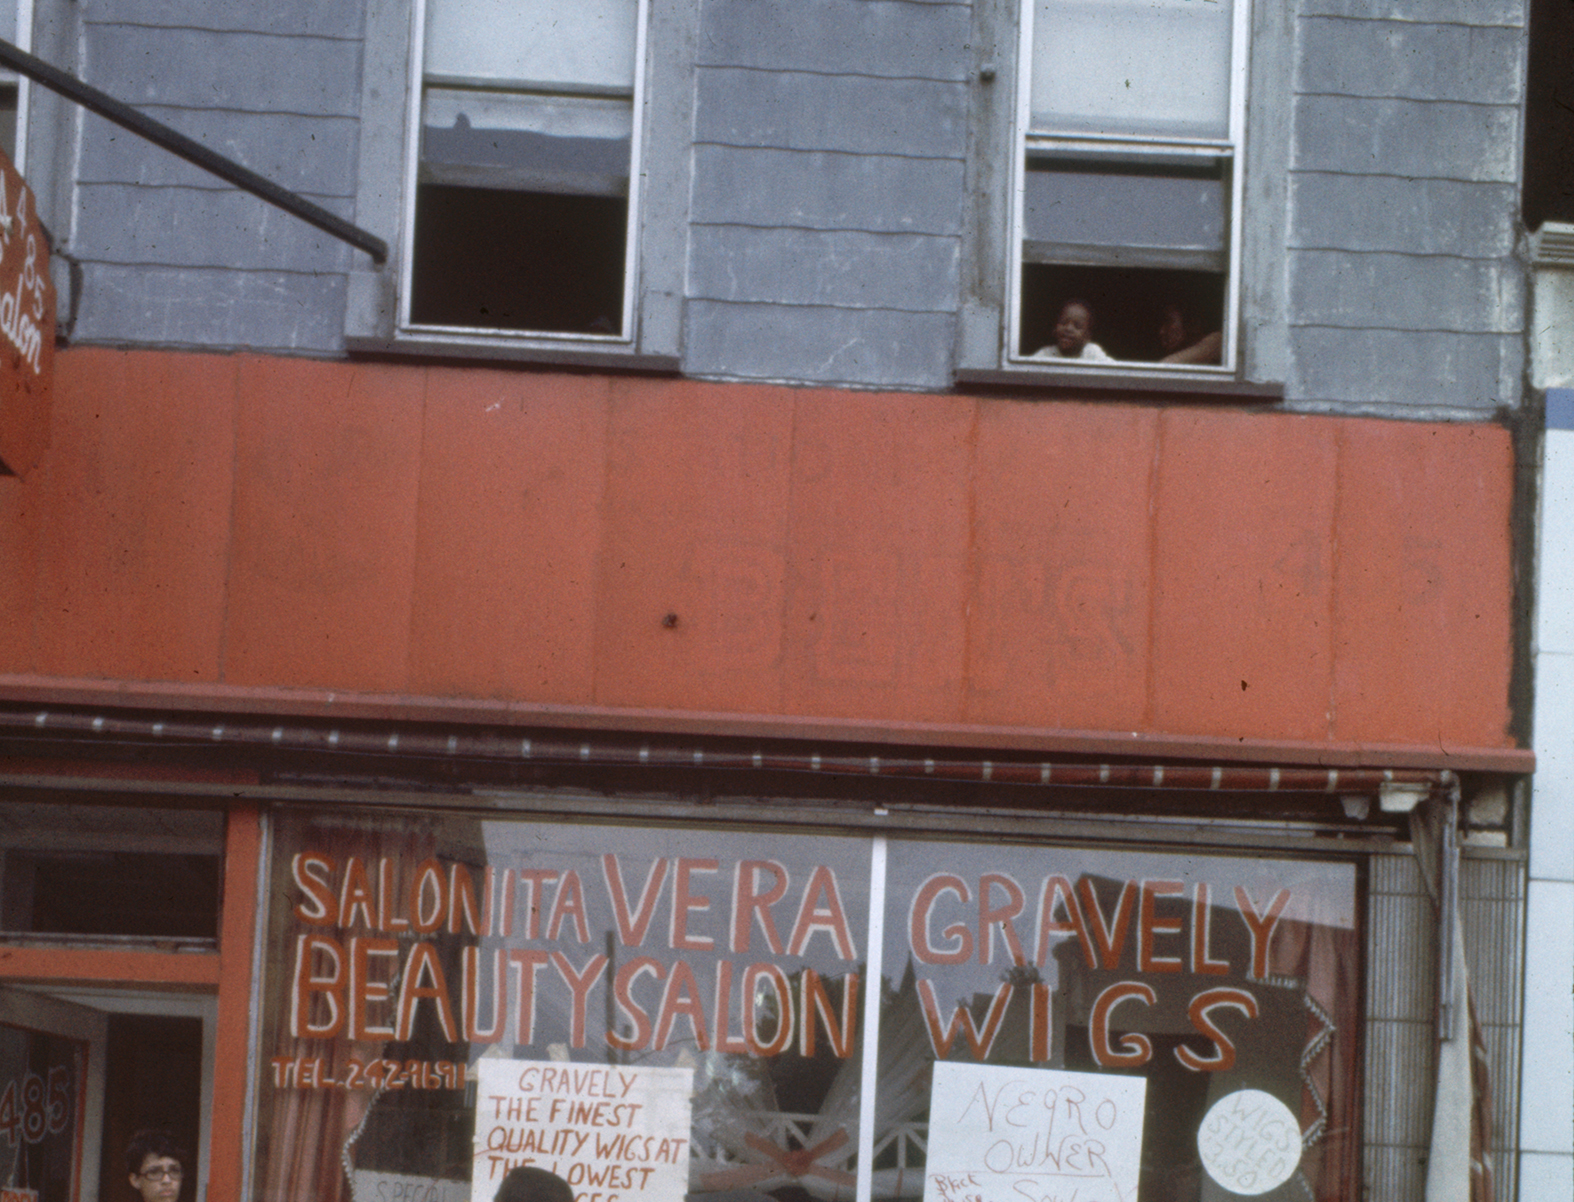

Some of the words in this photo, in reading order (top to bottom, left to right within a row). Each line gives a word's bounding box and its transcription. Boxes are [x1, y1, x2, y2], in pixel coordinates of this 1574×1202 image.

[292, 851, 592, 944] SALONITA
[602, 852, 859, 961] VERA
[907, 871, 1292, 979] GRAVELY
[290, 933, 610, 1050] BEAUTY
[603, 954, 860, 1060] SALON
[915, 978, 1259, 1073] WIGS
[518, 1066, 638, 1099] GRAVELY
[487, 1095, 542, 1122] THE
[549, 1098, 644, 1129] FINEST
[1230, 1091, 1300, 1152] WIGS
[486, 1125, 590, 1157] QUALITY
[595, 1132, 655, 1163] WIGS
[655, 1138, 688, 1165] AT
